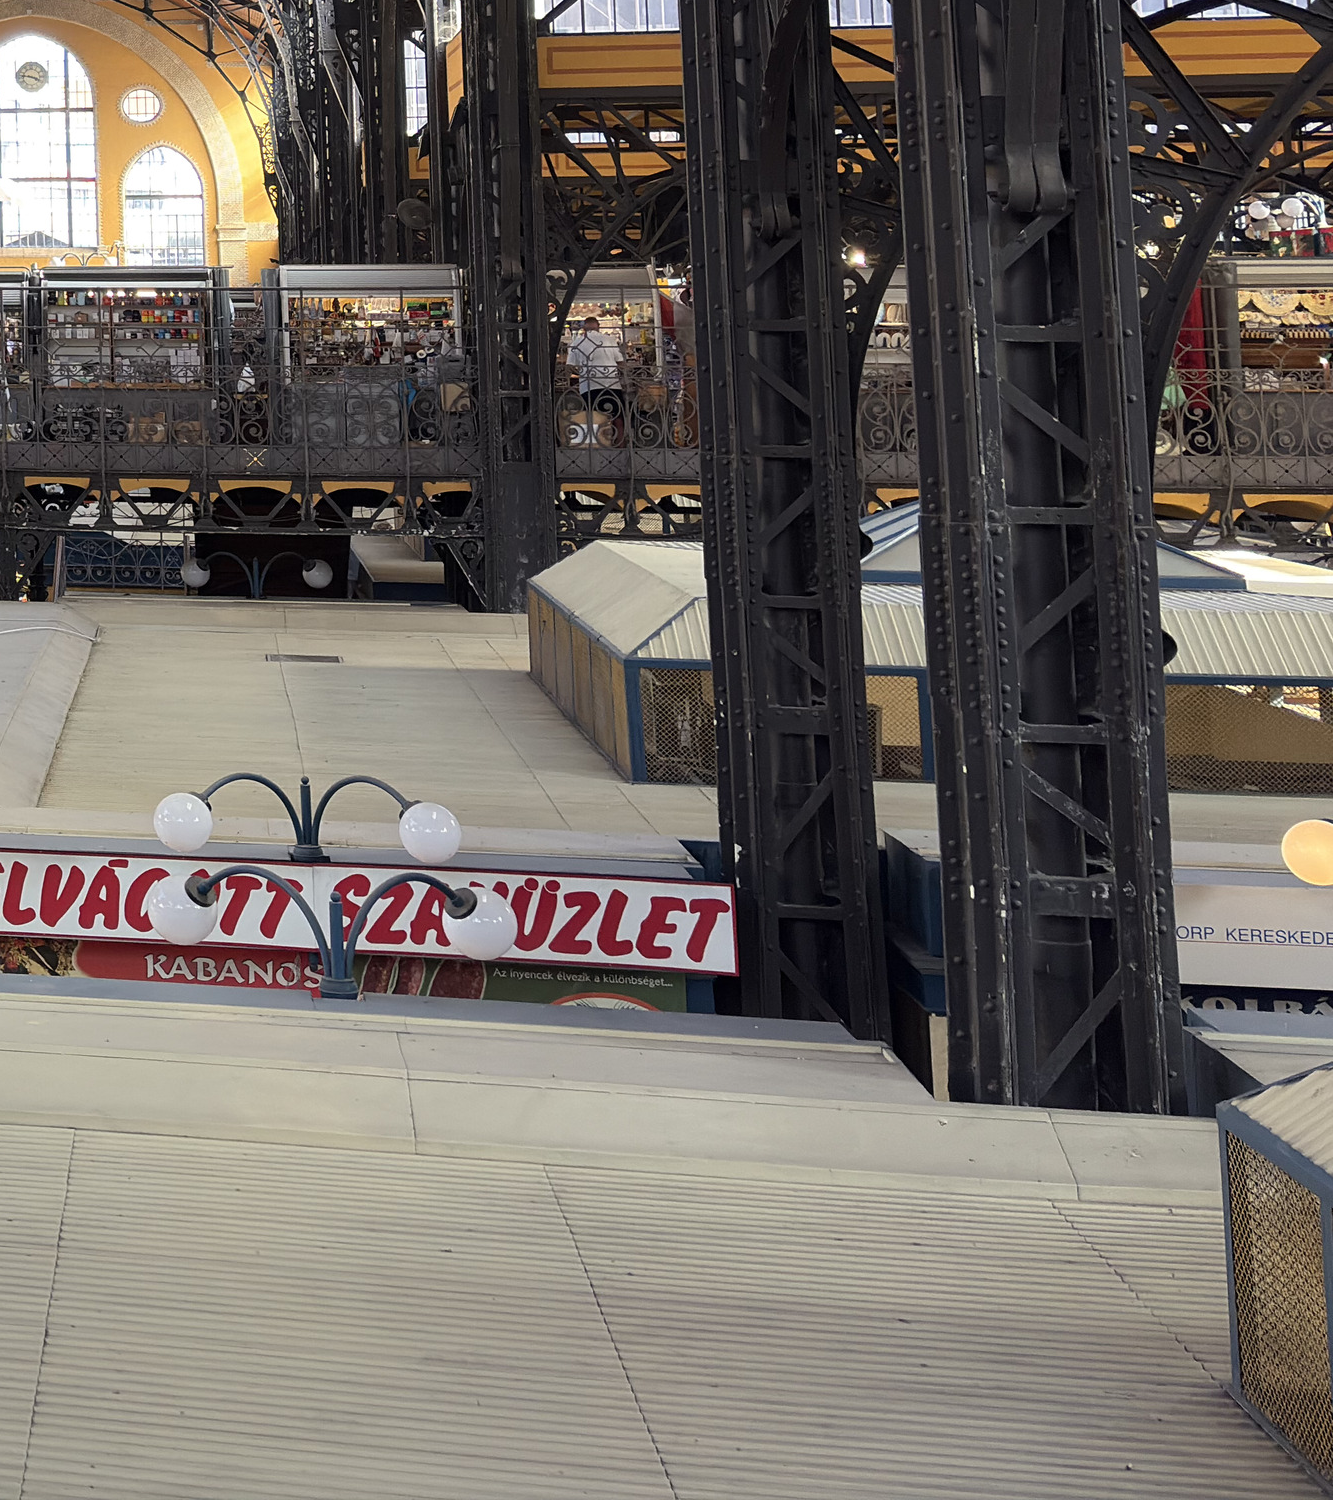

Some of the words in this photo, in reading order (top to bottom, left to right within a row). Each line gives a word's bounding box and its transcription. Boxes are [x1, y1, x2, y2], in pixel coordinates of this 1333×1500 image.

[333, 873, 730, 963] SZAÜZLET
[1176, 925, 1215, 940] ORP
[1226, 928, 1333, 946] KERESKEDE
[145, 954, 323, 989] KABANOS
[493, 968, 507, 979] Az
[557, 970, 592, 984] élvezik
[594, 975, 601, 984] a
